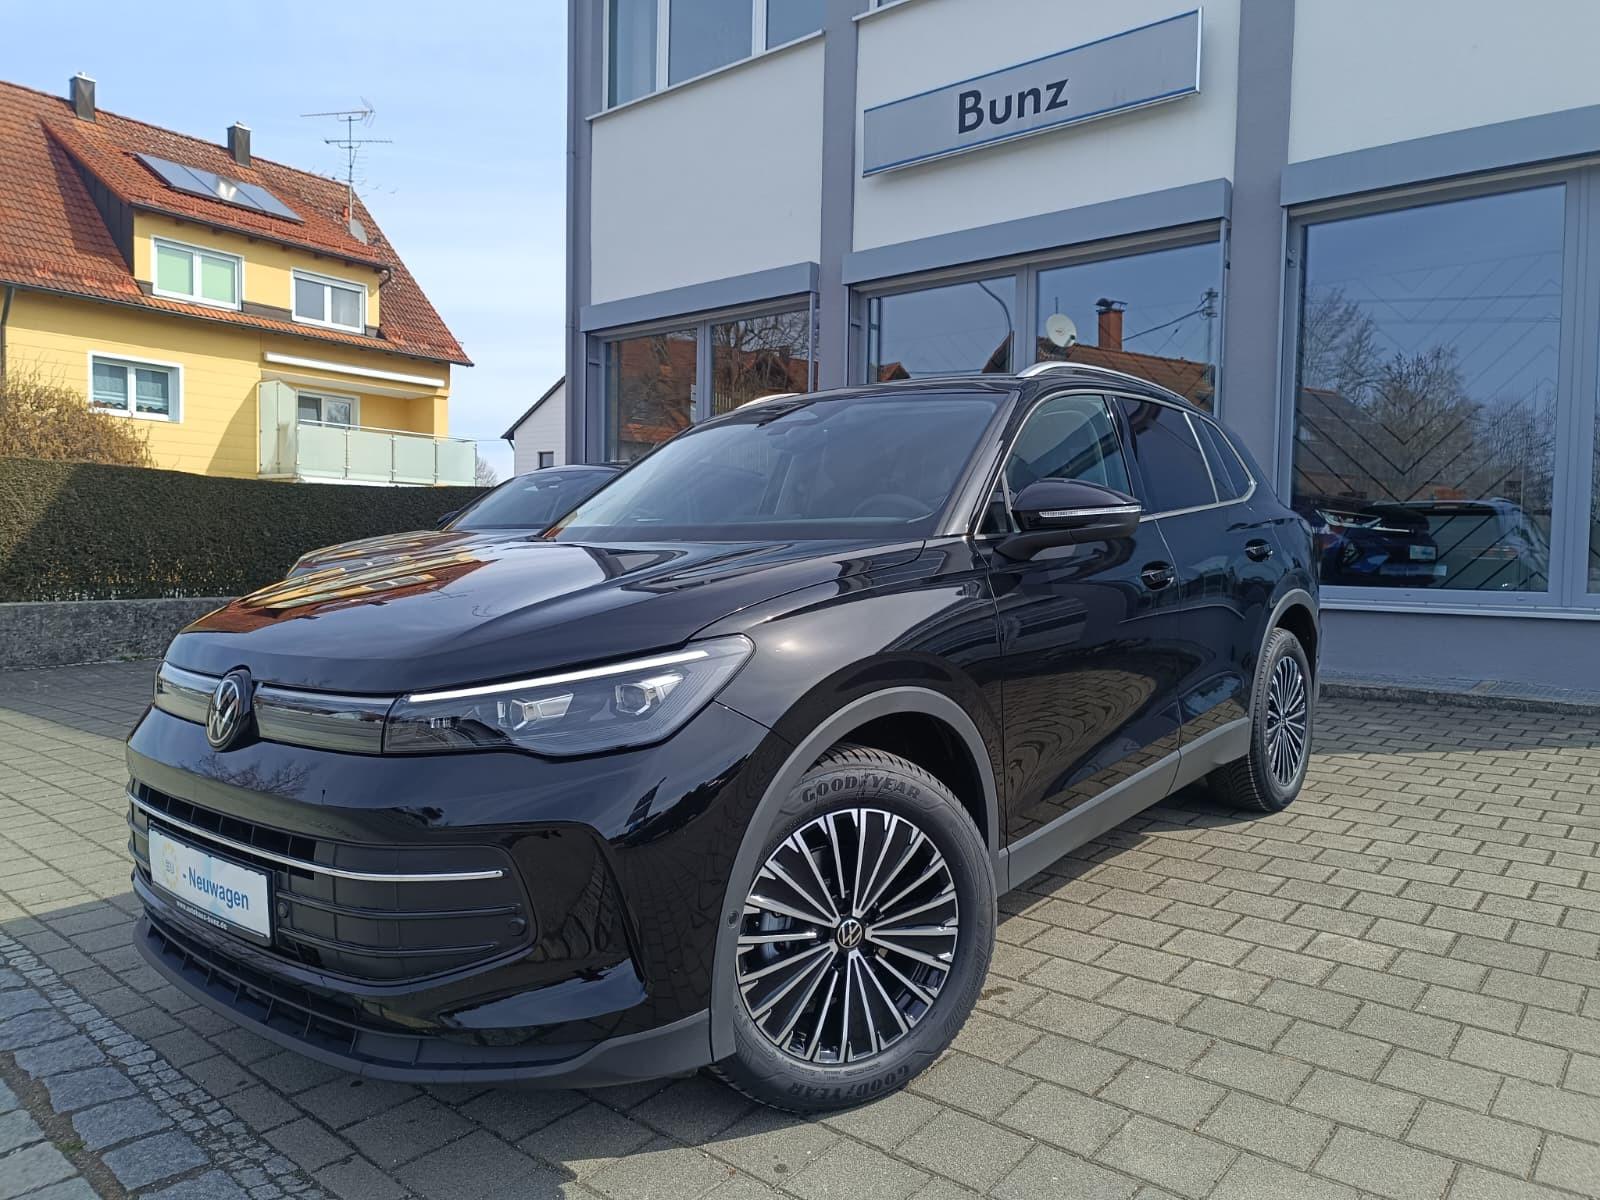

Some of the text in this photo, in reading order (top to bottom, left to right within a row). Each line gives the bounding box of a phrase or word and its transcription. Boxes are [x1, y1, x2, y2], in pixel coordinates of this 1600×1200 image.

[958, 79, 1069, 134] Bunz
[802, 775, 922, 802] GOODYEAR
[188, 866, 249, 910] Neuwagen
